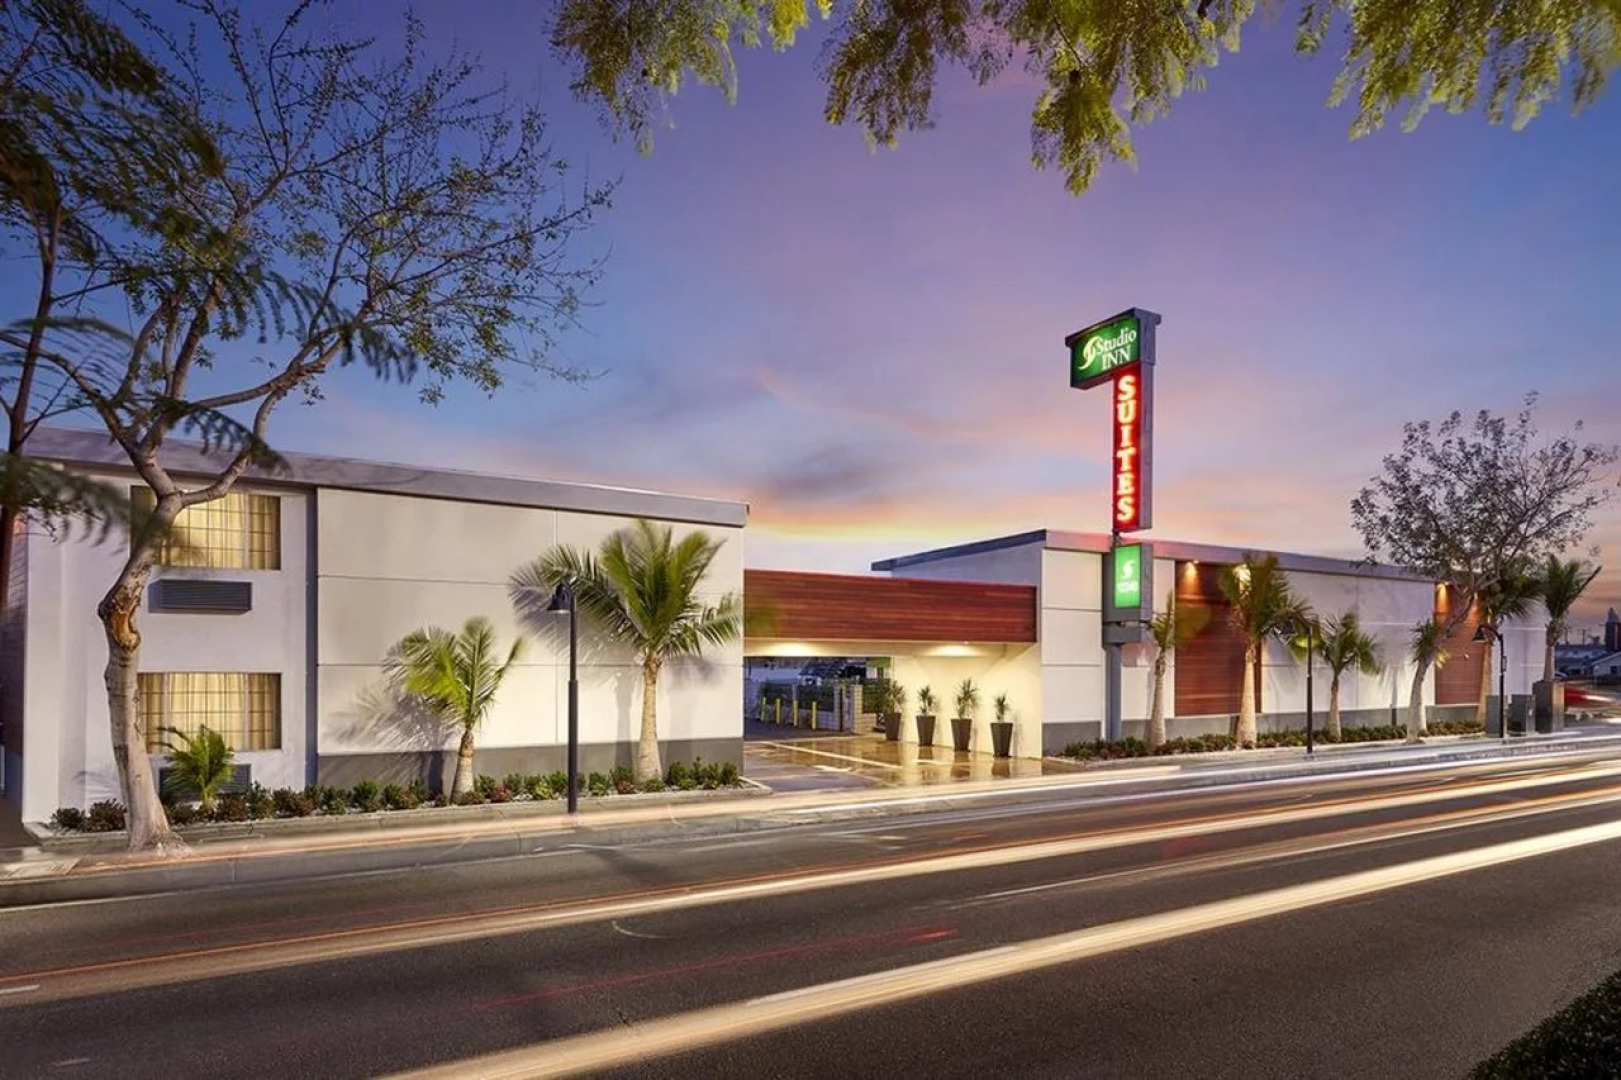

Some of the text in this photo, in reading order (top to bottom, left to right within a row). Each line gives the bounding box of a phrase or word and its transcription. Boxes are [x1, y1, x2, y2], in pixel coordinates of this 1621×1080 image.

[1095, 327, 1137, 356] Studio
[1102, 345, 1131, 370] INN
[1116, 375, 1137, 521] SUITES
